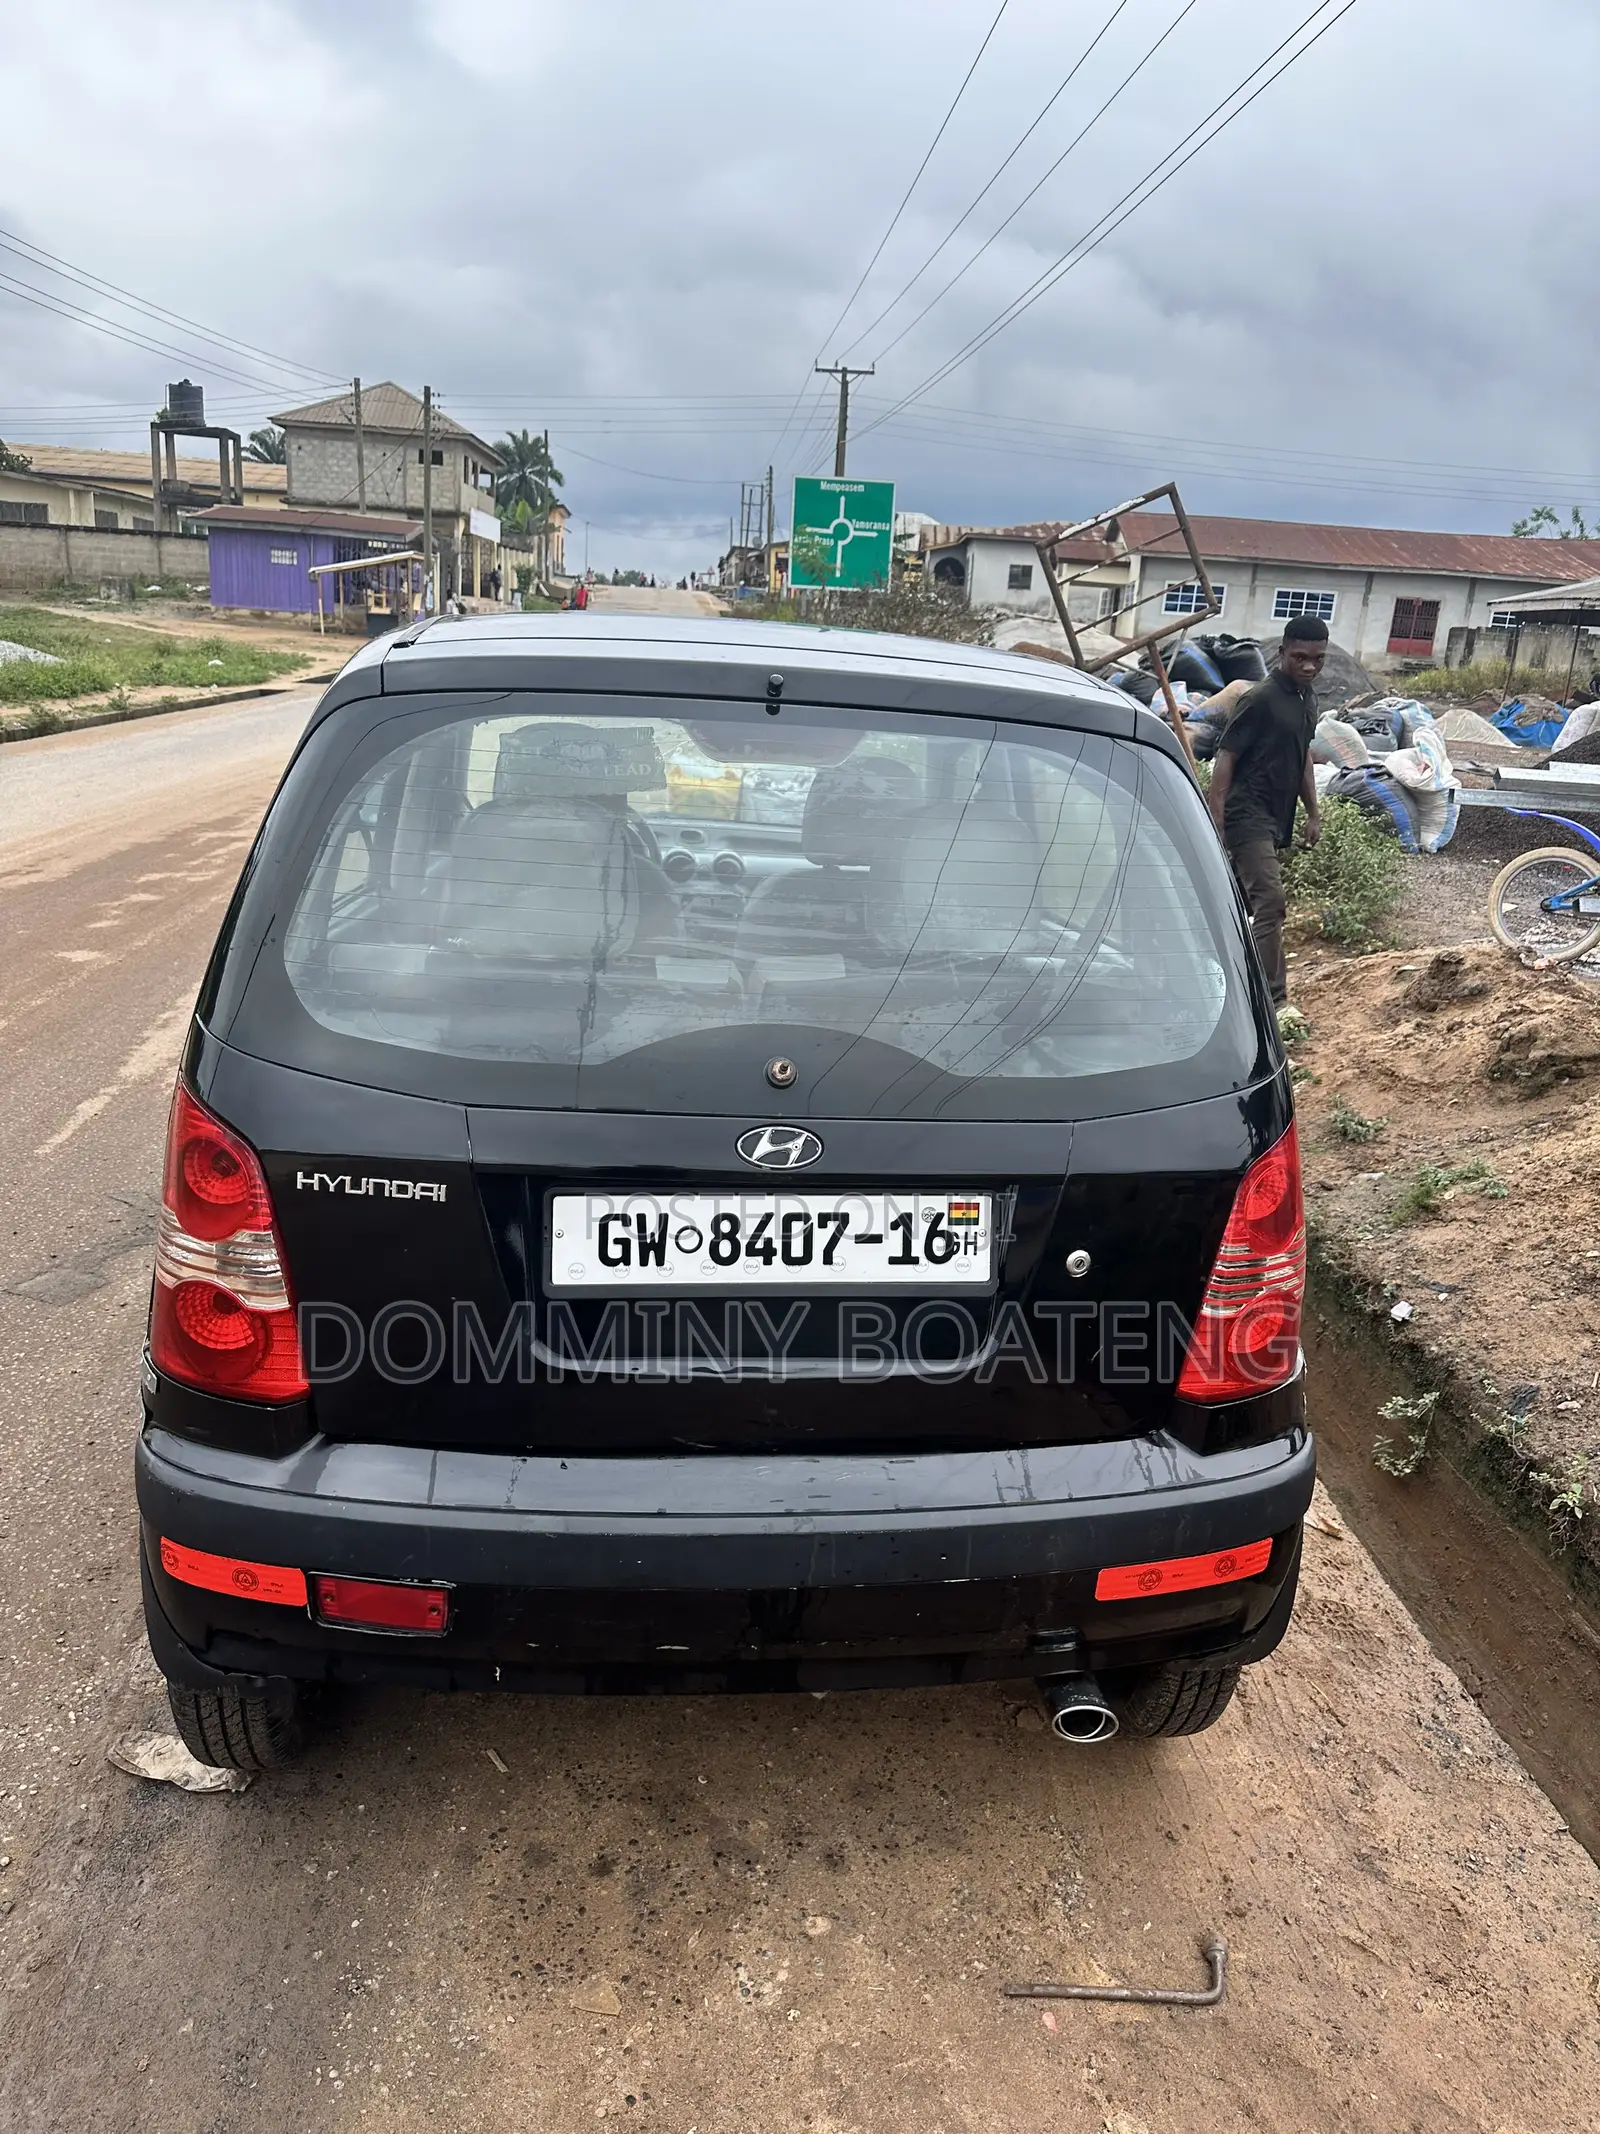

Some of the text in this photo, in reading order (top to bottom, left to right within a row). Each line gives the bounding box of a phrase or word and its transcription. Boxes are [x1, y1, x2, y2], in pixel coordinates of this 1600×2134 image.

[820, 480, 865, 493] Mempeasem
[851, 519, 890, 531] Yamoransa
[297, 1171, 448, 1202] HYUNDAI
[598, 1212, 955, 1268] GW 8407-16
[949, 1231, 978, 1256] GH
